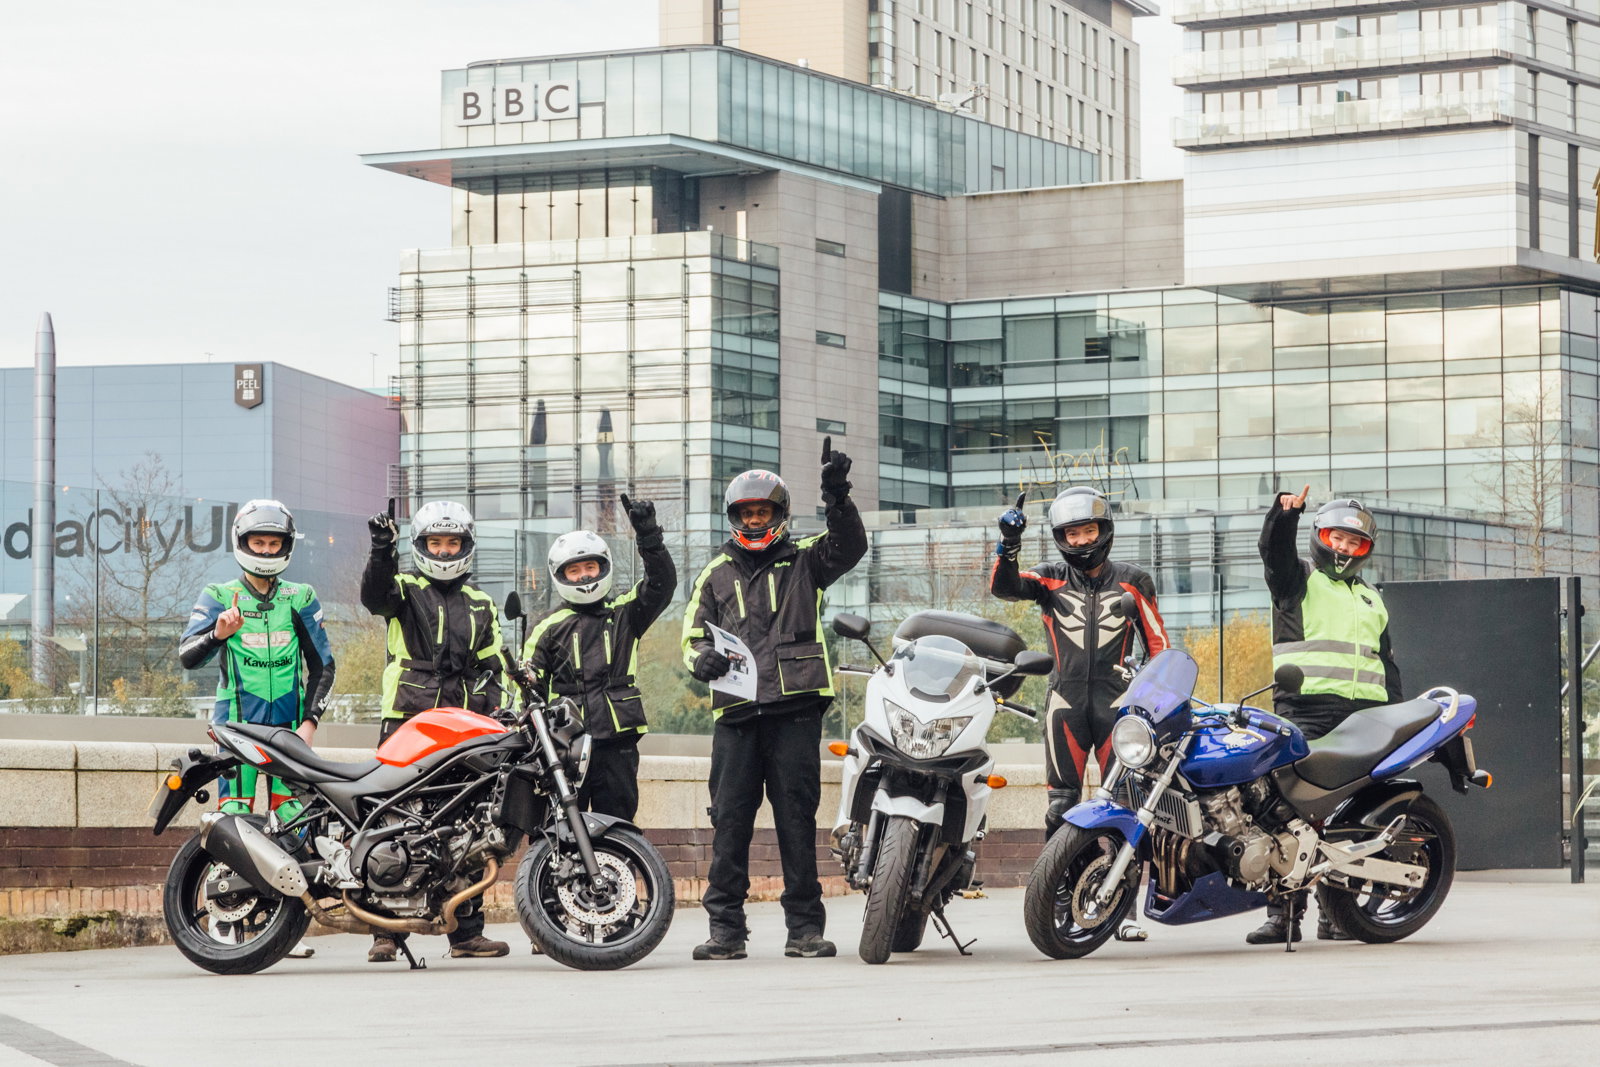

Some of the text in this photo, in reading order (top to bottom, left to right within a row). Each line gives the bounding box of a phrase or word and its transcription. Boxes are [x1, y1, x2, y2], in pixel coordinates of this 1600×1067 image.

[463, 85, 569, 120] BBC
[236, 379, 260, 390] PEEL
[243, 655, 293, 668] Kawasaki
